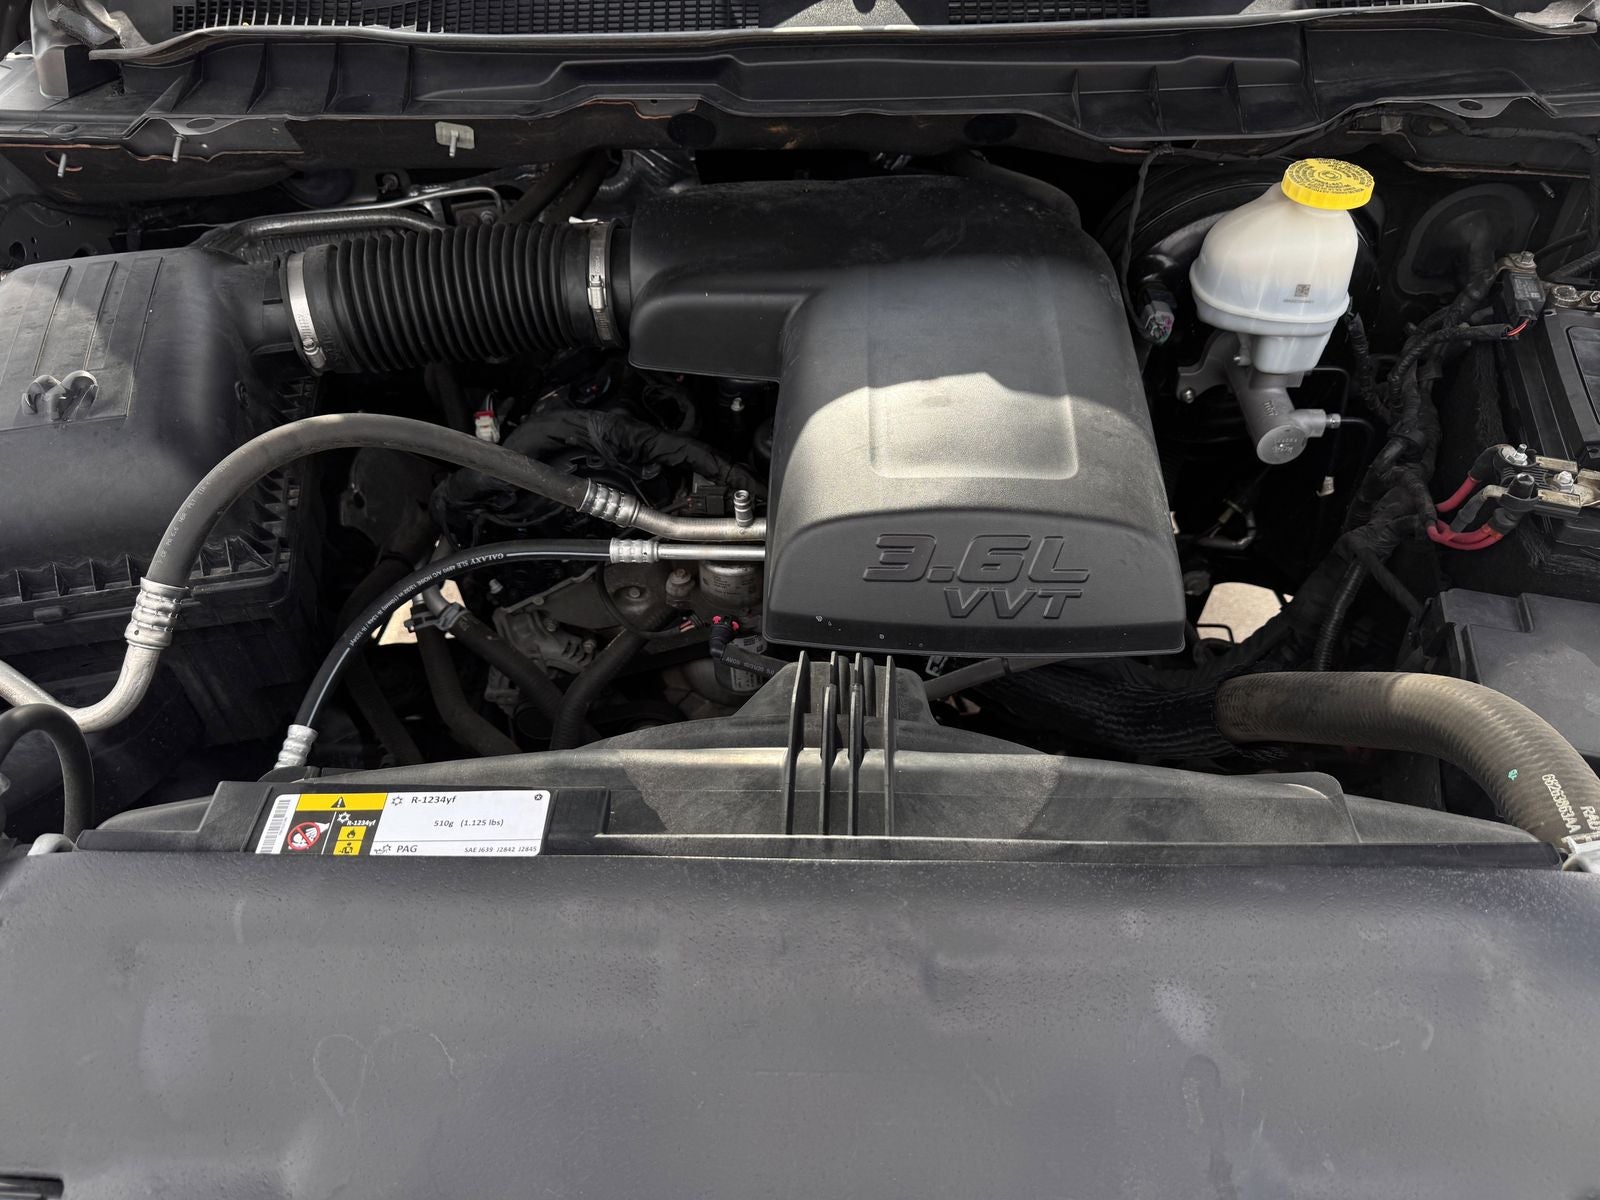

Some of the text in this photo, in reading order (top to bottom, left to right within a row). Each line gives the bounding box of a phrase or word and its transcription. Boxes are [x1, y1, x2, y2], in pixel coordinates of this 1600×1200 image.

[470, 552, 505, 564] GALAXY
[862, 533, 1090, 584] 3.6L
[456, 559, 469, 569] SLE
[432, 569, 443, 579] A/C
[416, 574, 433, 585] HOSE
[944, 587, 1083, 619] VVT
[411, 795, 456, 805] R-1234yf
[346, 819, 376, 827] R-1234yf
[434, 819, 504, 828] 510g (1.125 lbs)
[396, 844, 418, 853] PAG
